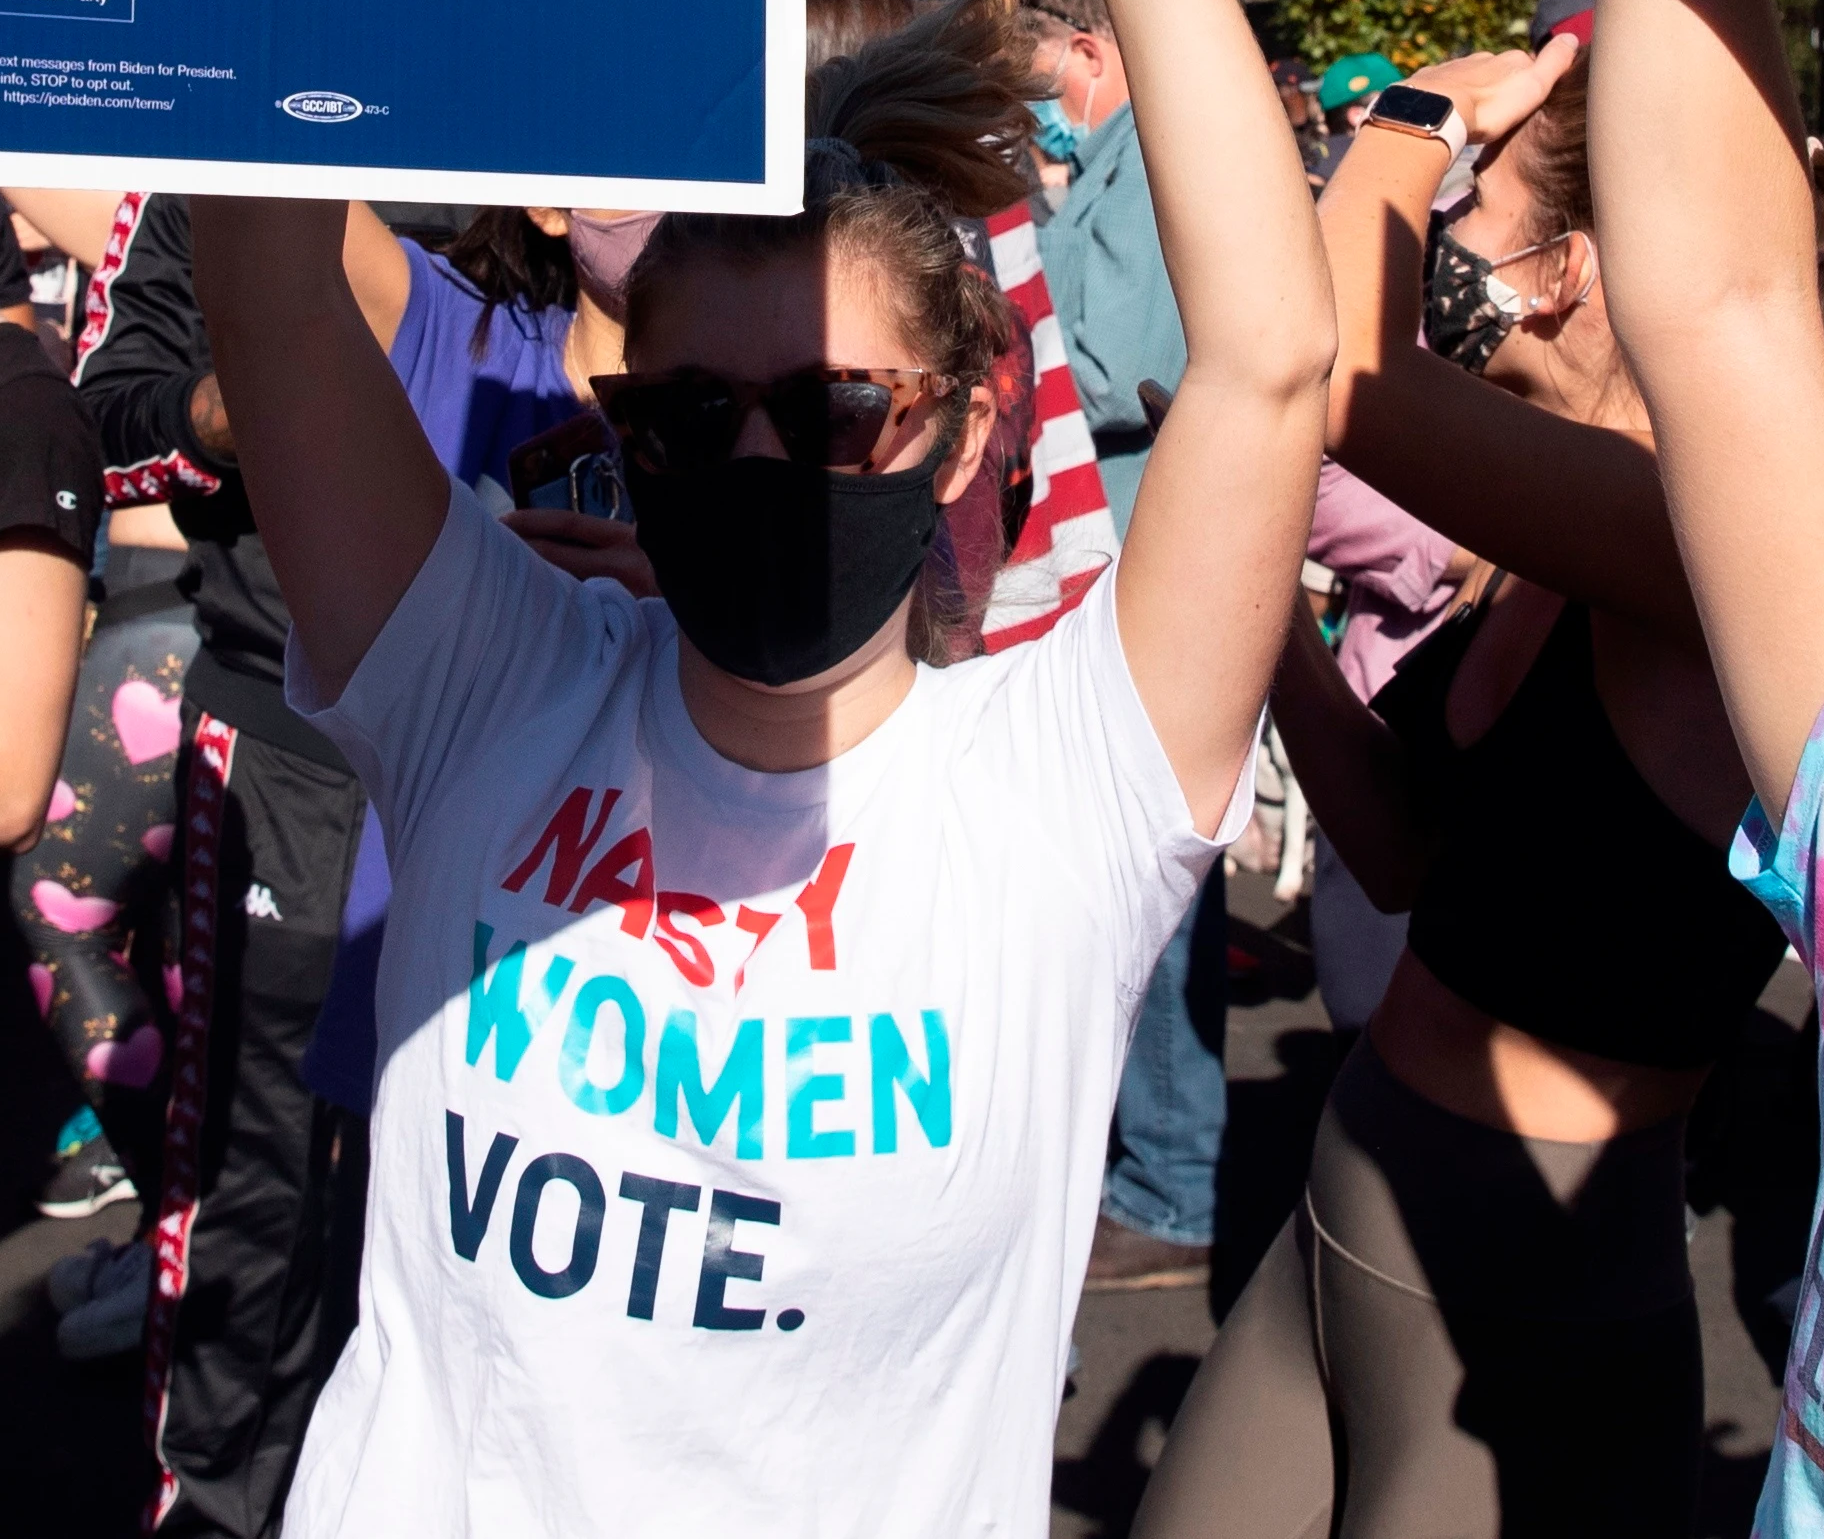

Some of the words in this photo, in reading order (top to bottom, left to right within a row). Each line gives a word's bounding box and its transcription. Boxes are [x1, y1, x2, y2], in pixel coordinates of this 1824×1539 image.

[0, 73, 27, 86] info,
[31, 74, 68, 87] STOP
[71, 77, 84, 88] to
[87, 79, 107, 91] opt
[111, 80, 133, 91] out.
[22, 58, 85, 73] messages
[88, 59, 116, 72] from
[120, 61, 154, 74] Biden
[158, 63, 174, 75] for
[178, 64, 236, 79] President.
[364, 105, 389, 115] 473-C
[501, 786, 856, 994] NASTY
[463, 920, 953, 1159] WOMEN
[444, 1109, 807, 1332] VOTE.
